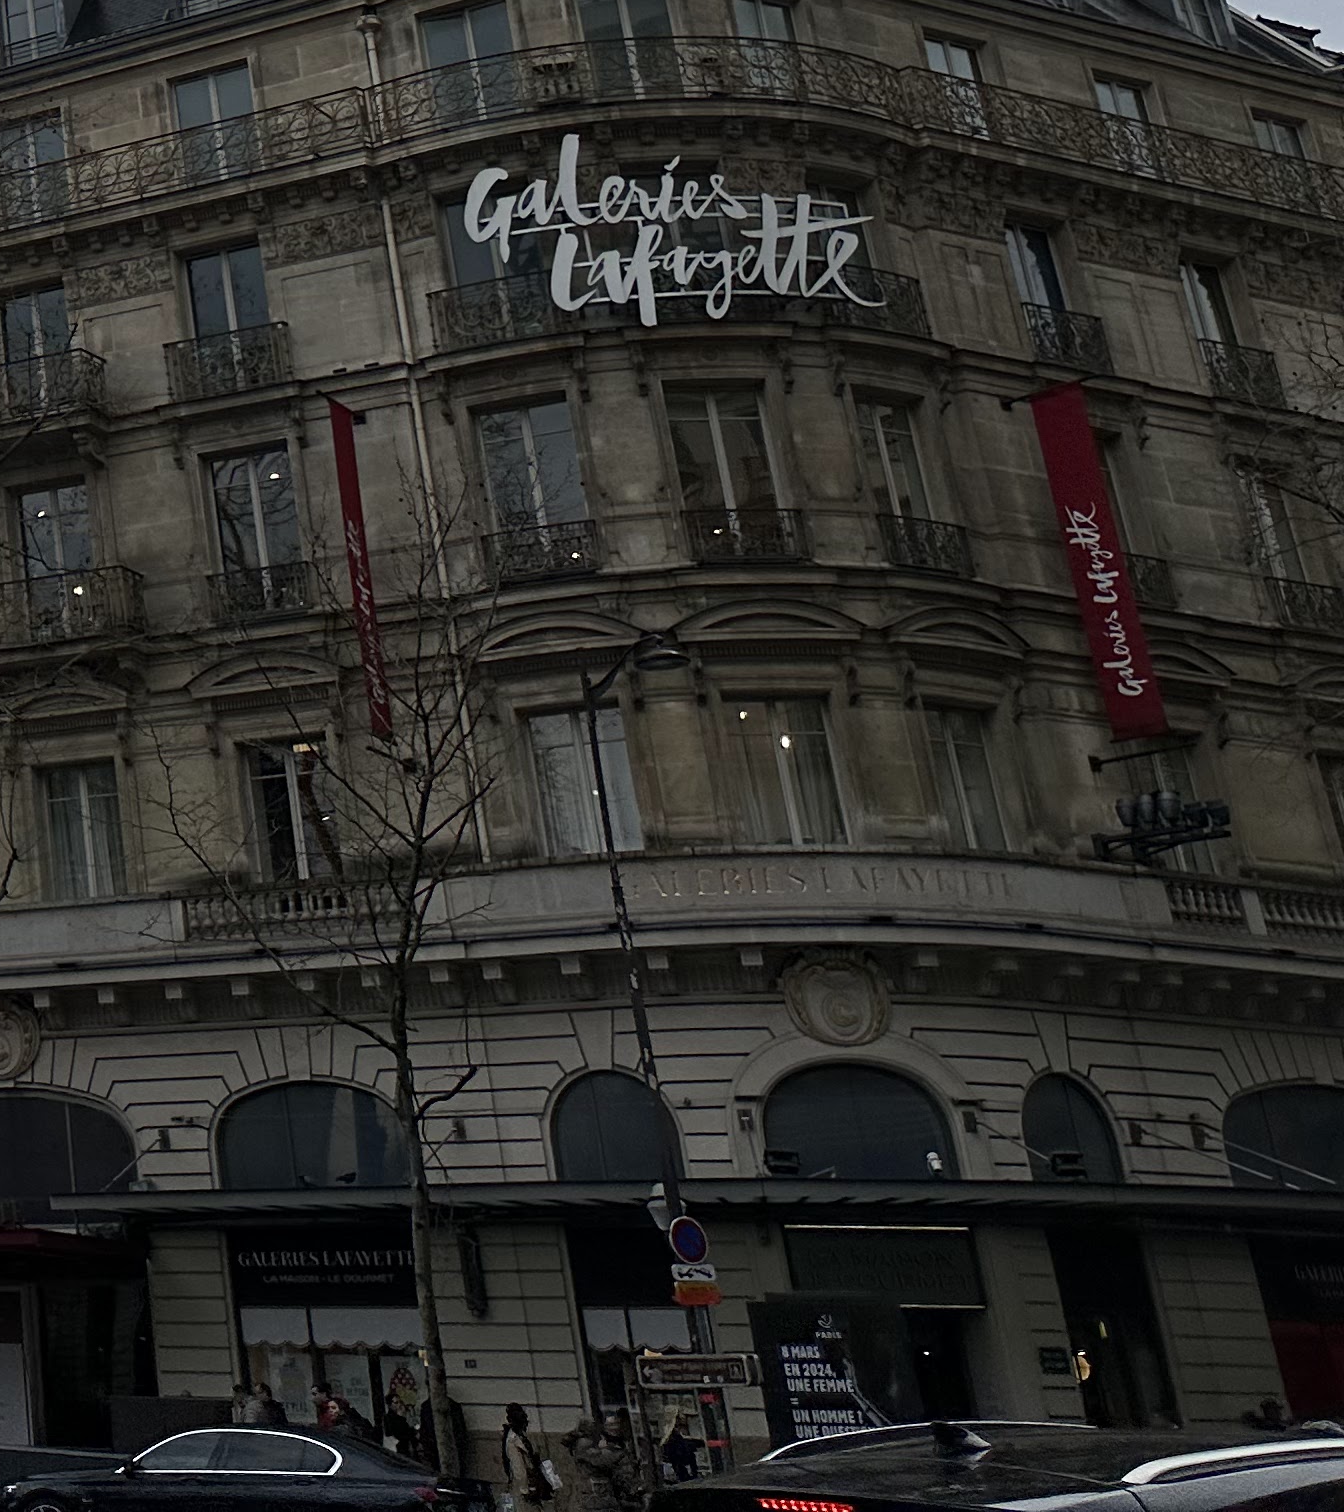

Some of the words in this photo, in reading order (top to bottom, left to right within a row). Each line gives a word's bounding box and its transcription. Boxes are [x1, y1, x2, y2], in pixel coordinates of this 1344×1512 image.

[464, 133, 748, 263] Galeries
[551, 193, 888, 327] Lafayette
[1065, 501, 1120, 604] Lafayette
[1103, 609, 1148, 697] Galeries
[237, 1251, 320, 1268] GALERIES
[790, 1345, 820, 1359] MARS
[784, 1363, 801, 1377] EN
[786, 1378, 812, 1392] UNE
[812, 1378, 855, 1393] FEMME
[792, 1409, 810, 1423] UN
[811, 1409, 856, 1424] HOMME
[795, 1424, 820, 1439] UNE
